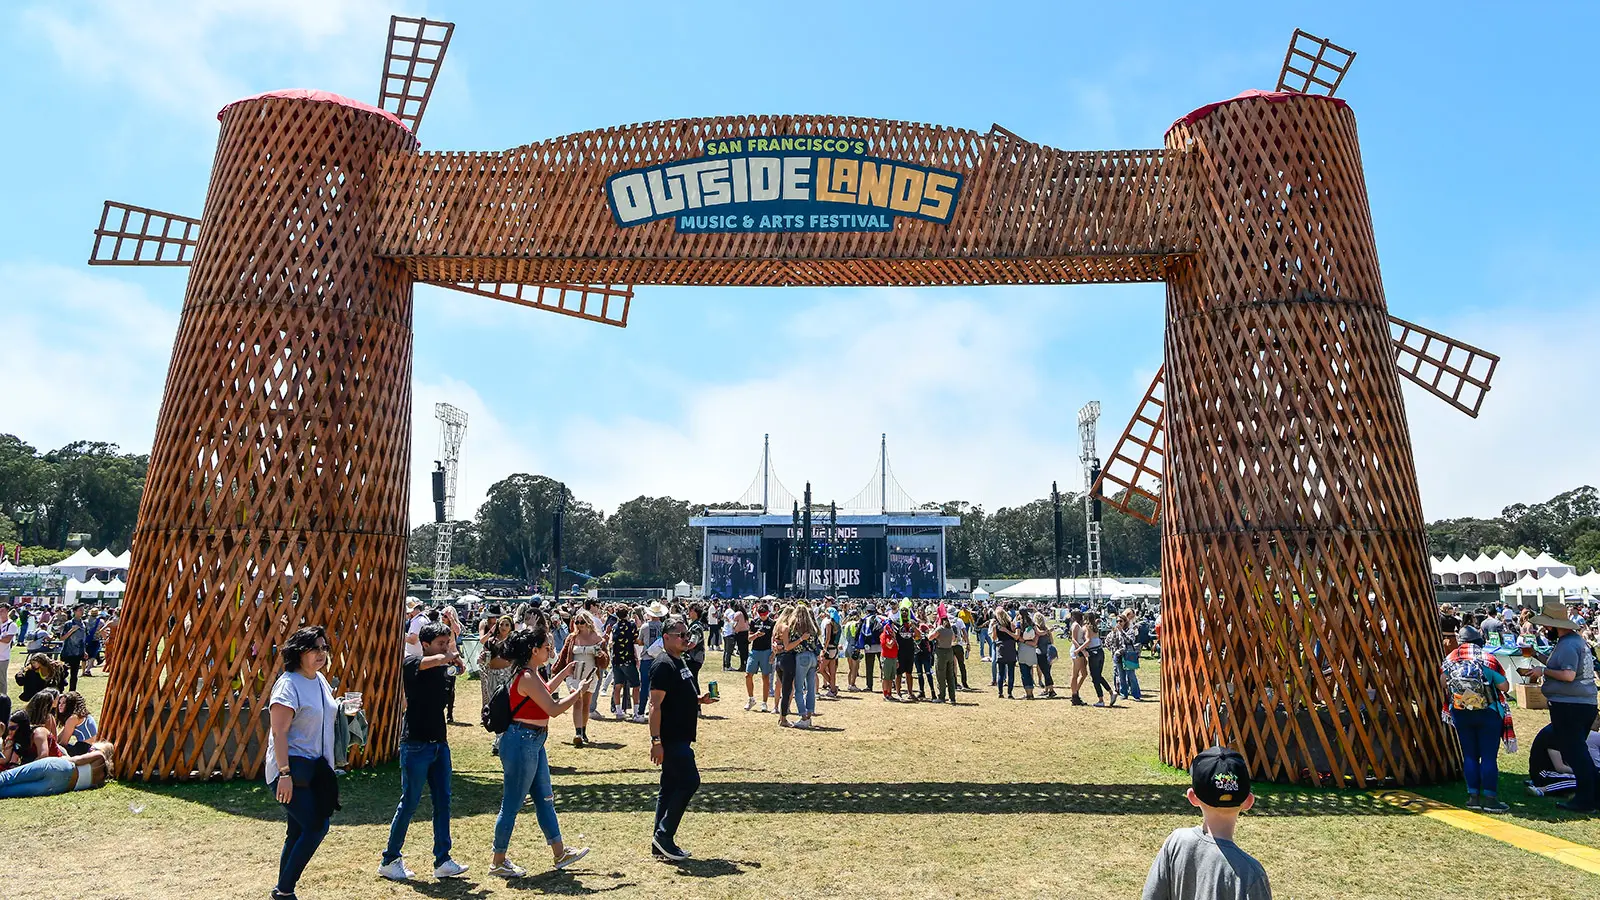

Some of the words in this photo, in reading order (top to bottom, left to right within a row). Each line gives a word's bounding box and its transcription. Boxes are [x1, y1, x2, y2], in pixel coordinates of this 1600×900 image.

[707, 139, 742, 156] SAN
[611, 157, 811, 223] OUTSIDE
[816, 157, 958, 220] LANDS
[680, 215, 738, 229] MUSIC
[742, 215, 753, 229] &
[759, 215, 804, 229] ARTS
[809, 214, 889, 229] FESTIVAL
[828, 527, 858, 538] LNDS
